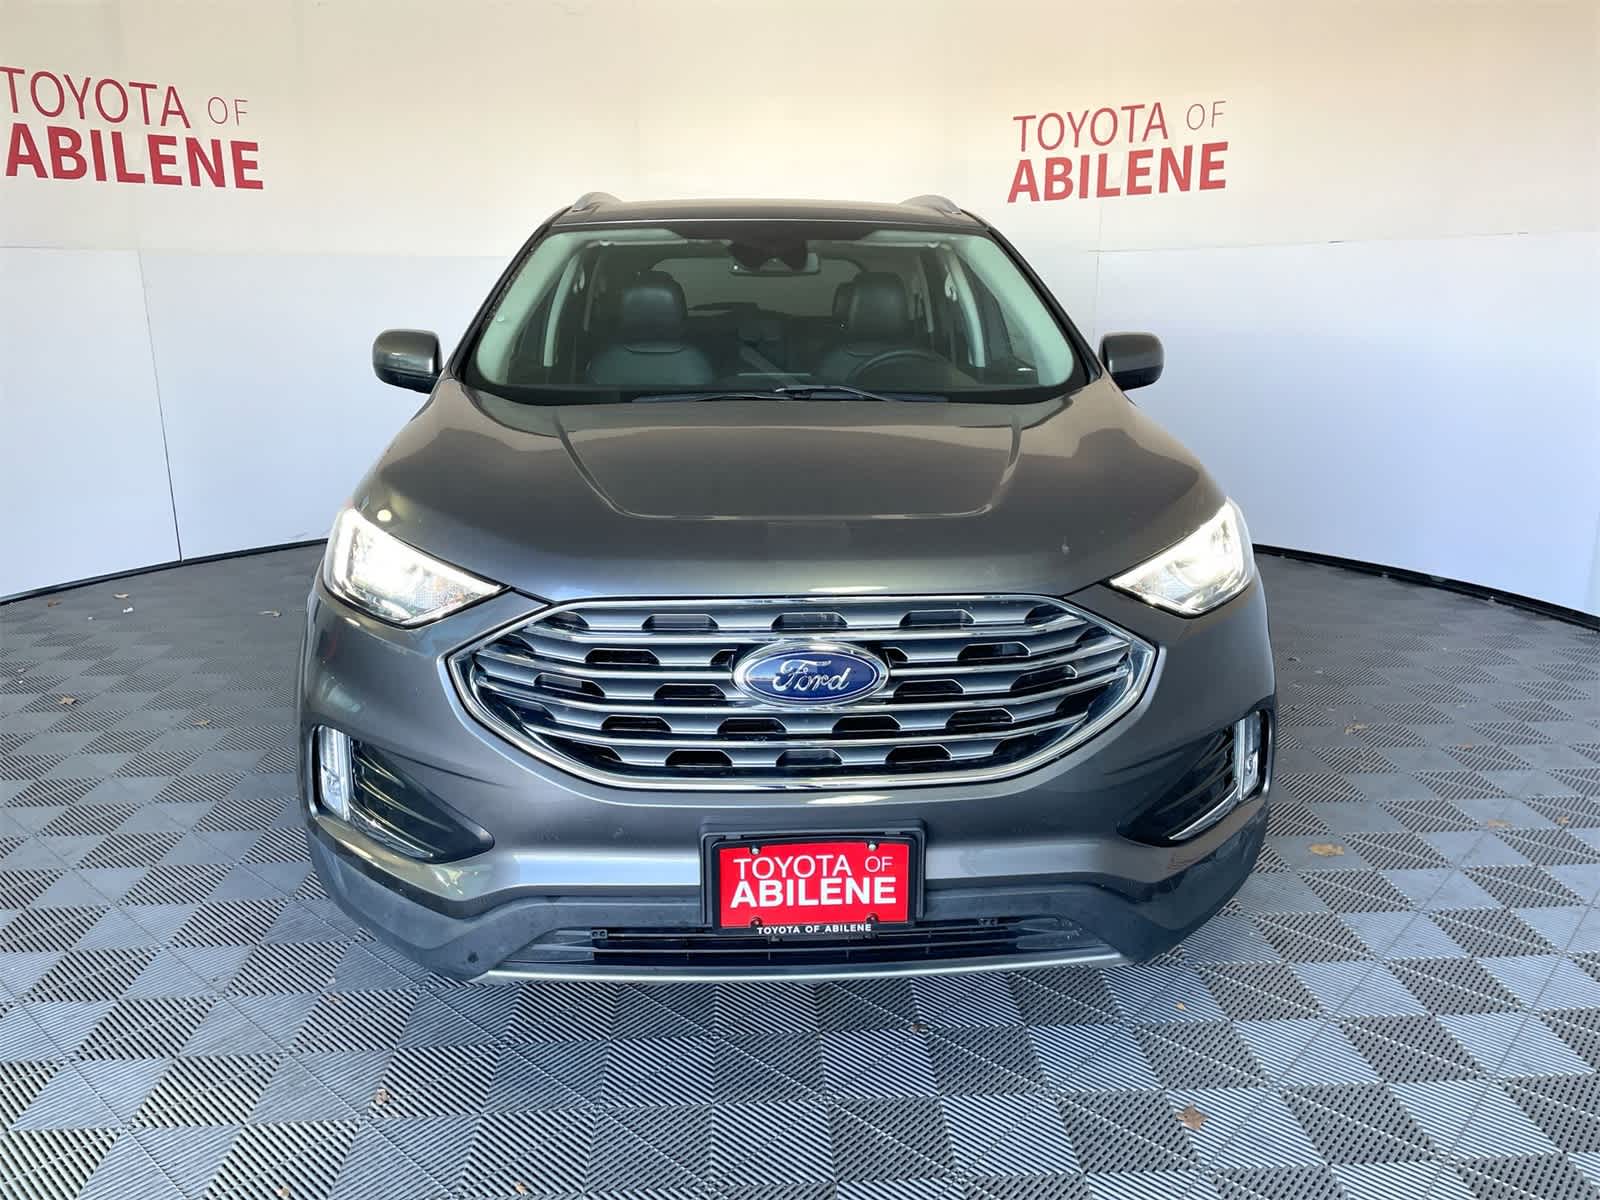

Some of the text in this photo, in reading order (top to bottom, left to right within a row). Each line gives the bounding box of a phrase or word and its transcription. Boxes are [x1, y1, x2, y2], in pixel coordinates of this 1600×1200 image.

[0, 66, 249, 129] TOYOTA OF
[1012, 100, 1227, 152] TOYOTA OF
[5, 122, 264, 190] ABILENE
[1007, 141, 1229, 203] ABILENE
[772, 659, 851, 692] Ford
[733, 854, 894, 880] TOYOTA OF
[730, 876, 897, 909] ABILENE
[756, 923, 872, 935] TOYOTA OF ABILENE
